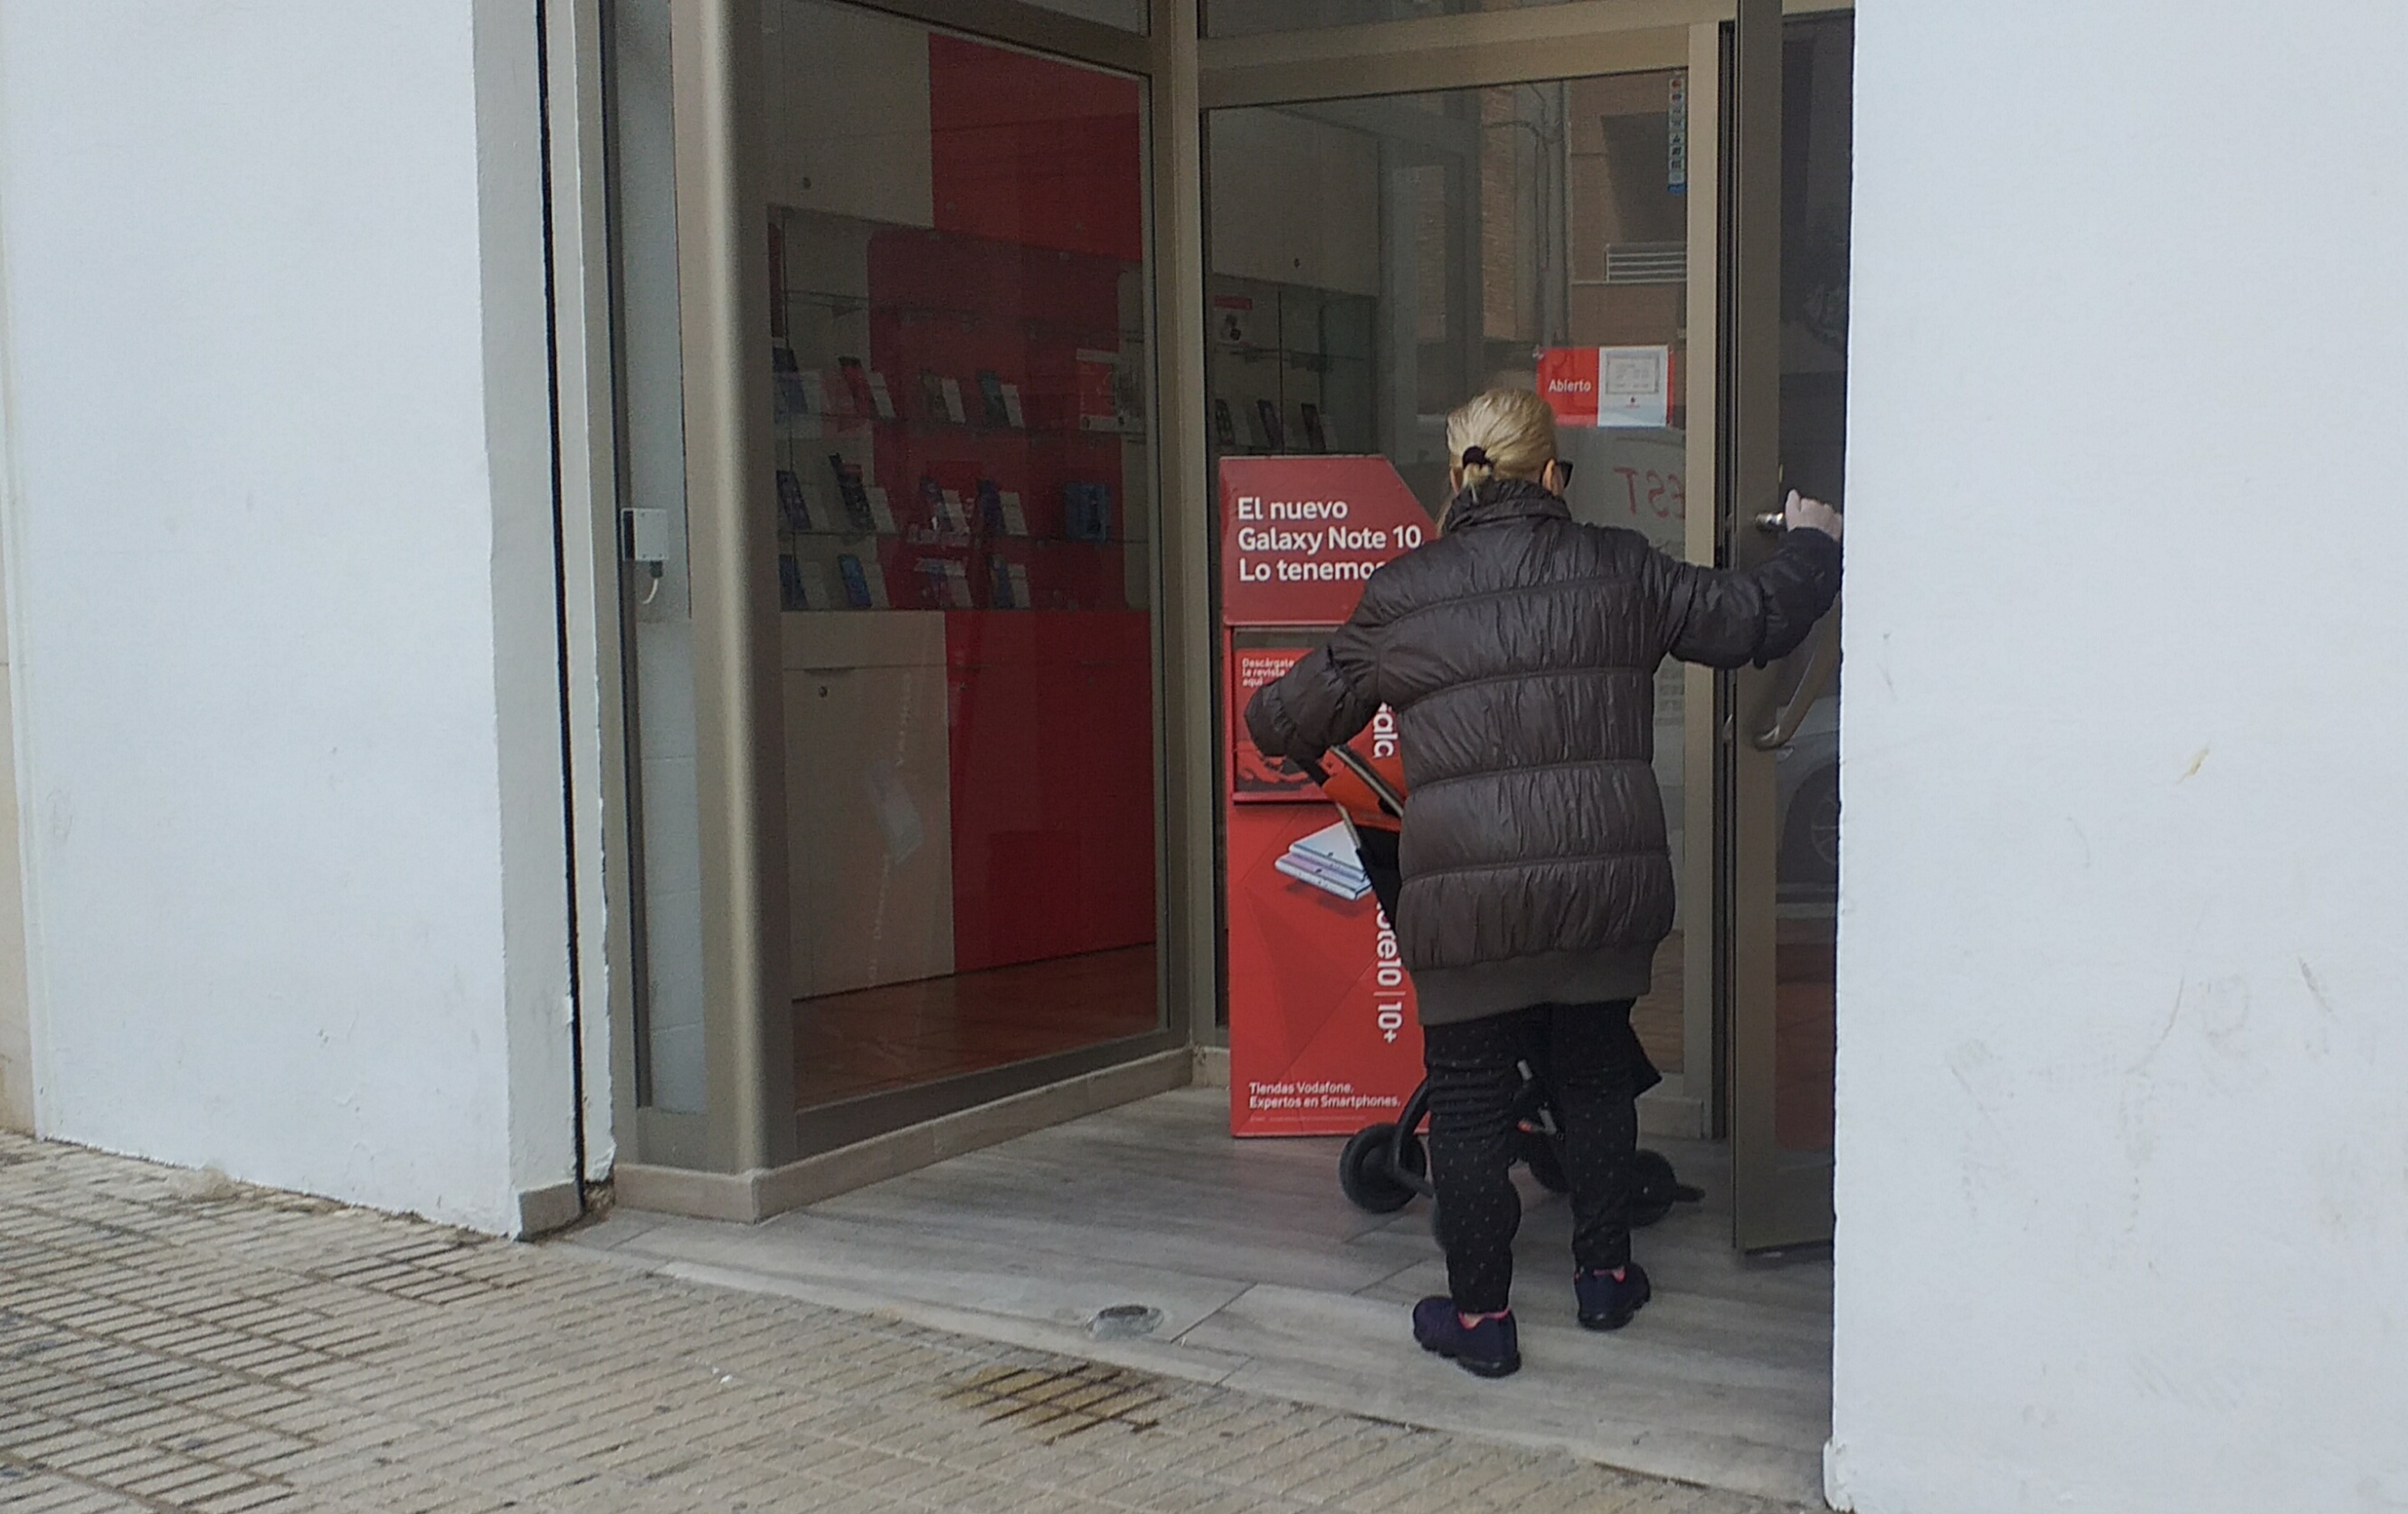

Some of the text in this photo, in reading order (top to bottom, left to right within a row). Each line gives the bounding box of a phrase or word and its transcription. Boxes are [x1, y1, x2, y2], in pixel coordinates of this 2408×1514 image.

[1549, 378, 1592, 393] Abierto
[1237, 497, 1348, 520] El nuevo
[1237, 527, 1323, 555] Galaxy
[1328, 525, 1387, 550] Note
[1239, 557, 1271, 582] Lo
[1376, 902, 1402, 987] ote10
[1378, 1001, 1402, 1044] 10+
[1249, 1082, 1294, 1094] Tiendas
[1249, 1095, 1301, 1111] Expertos
[1304, 1097, 1319, 1108] en
